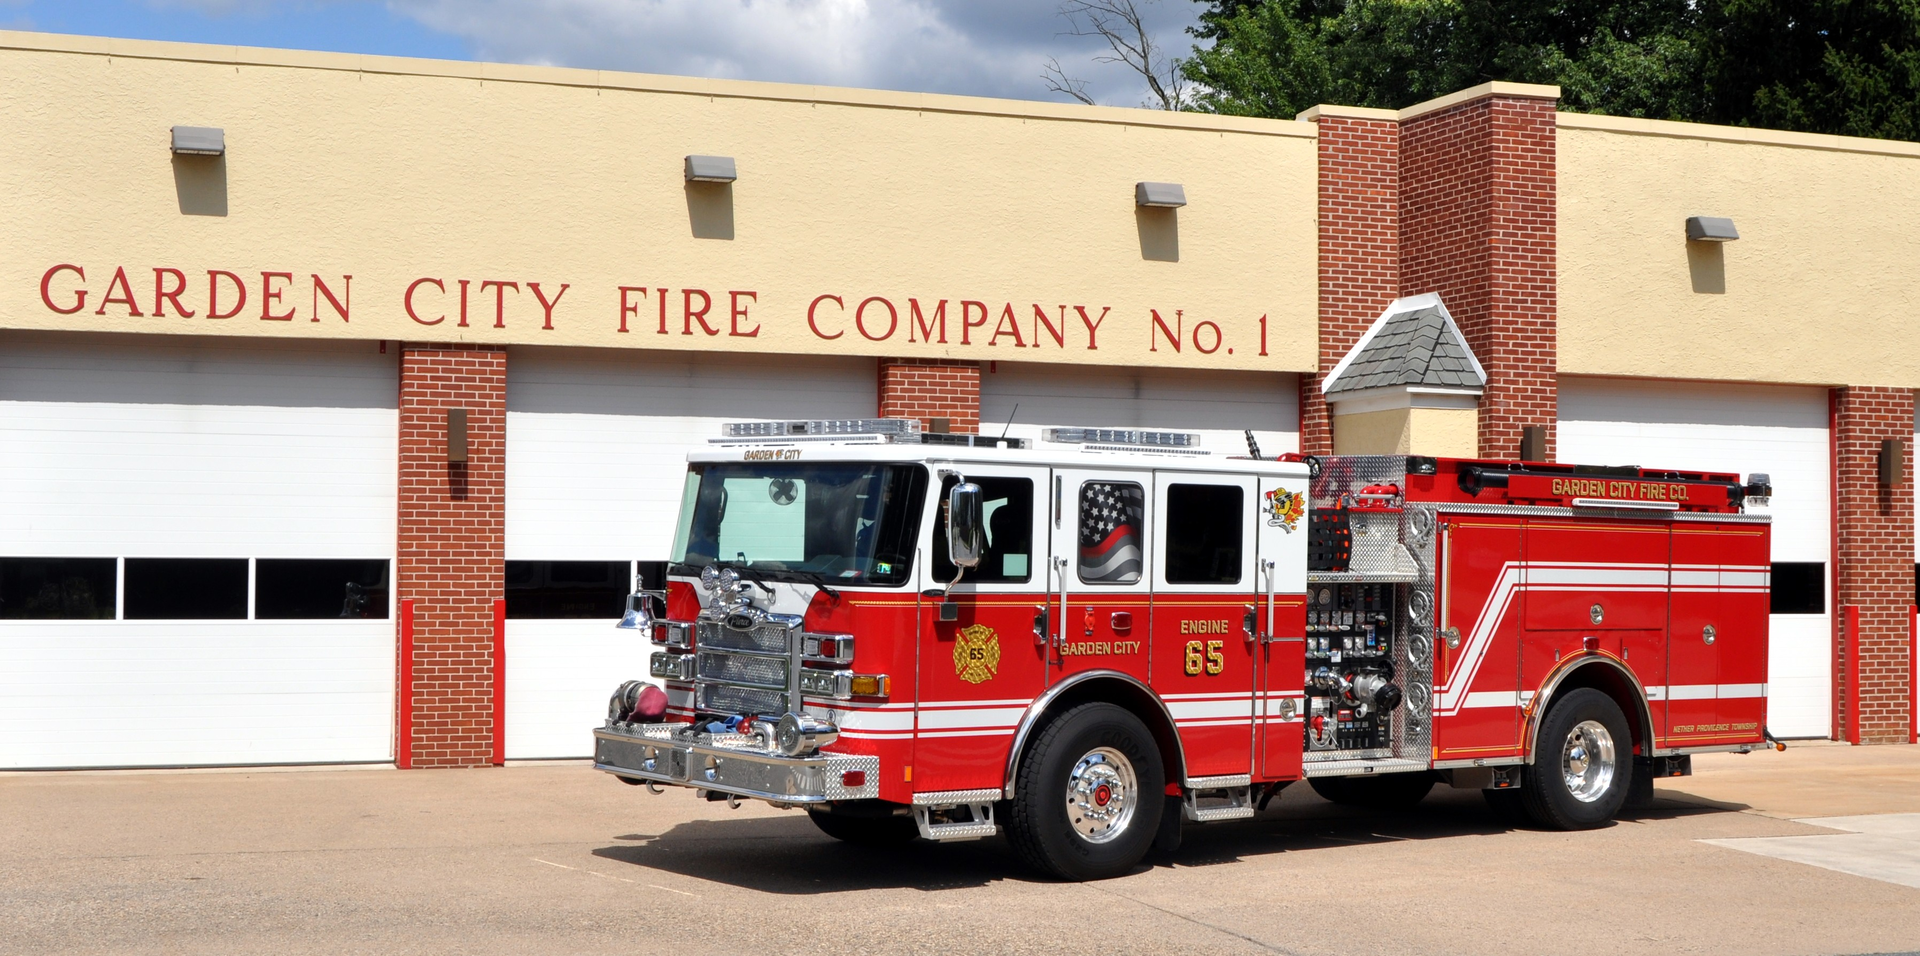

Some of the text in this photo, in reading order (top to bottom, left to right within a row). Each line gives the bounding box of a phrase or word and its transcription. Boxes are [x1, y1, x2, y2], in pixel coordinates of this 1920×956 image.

[40, 263, 1269, 357] GARDEN CITY FIRE COMPANY No. 1
[743, 448, 803, 461] GARDEN CITY
[1551, 478, 1690, 501] GARDEN CITY FIRE CO.
[1180, 619, 1229, 635] ENGINE
[969, 647, 984, 660] 65
[1059, 640, 1141, 656] GARDEN CITY
[1184, 639, 1224, 676] 65
[1672, 725, 1695, 733] NETHER
[1731, 722, 1758, 731] TOWNSHIP
